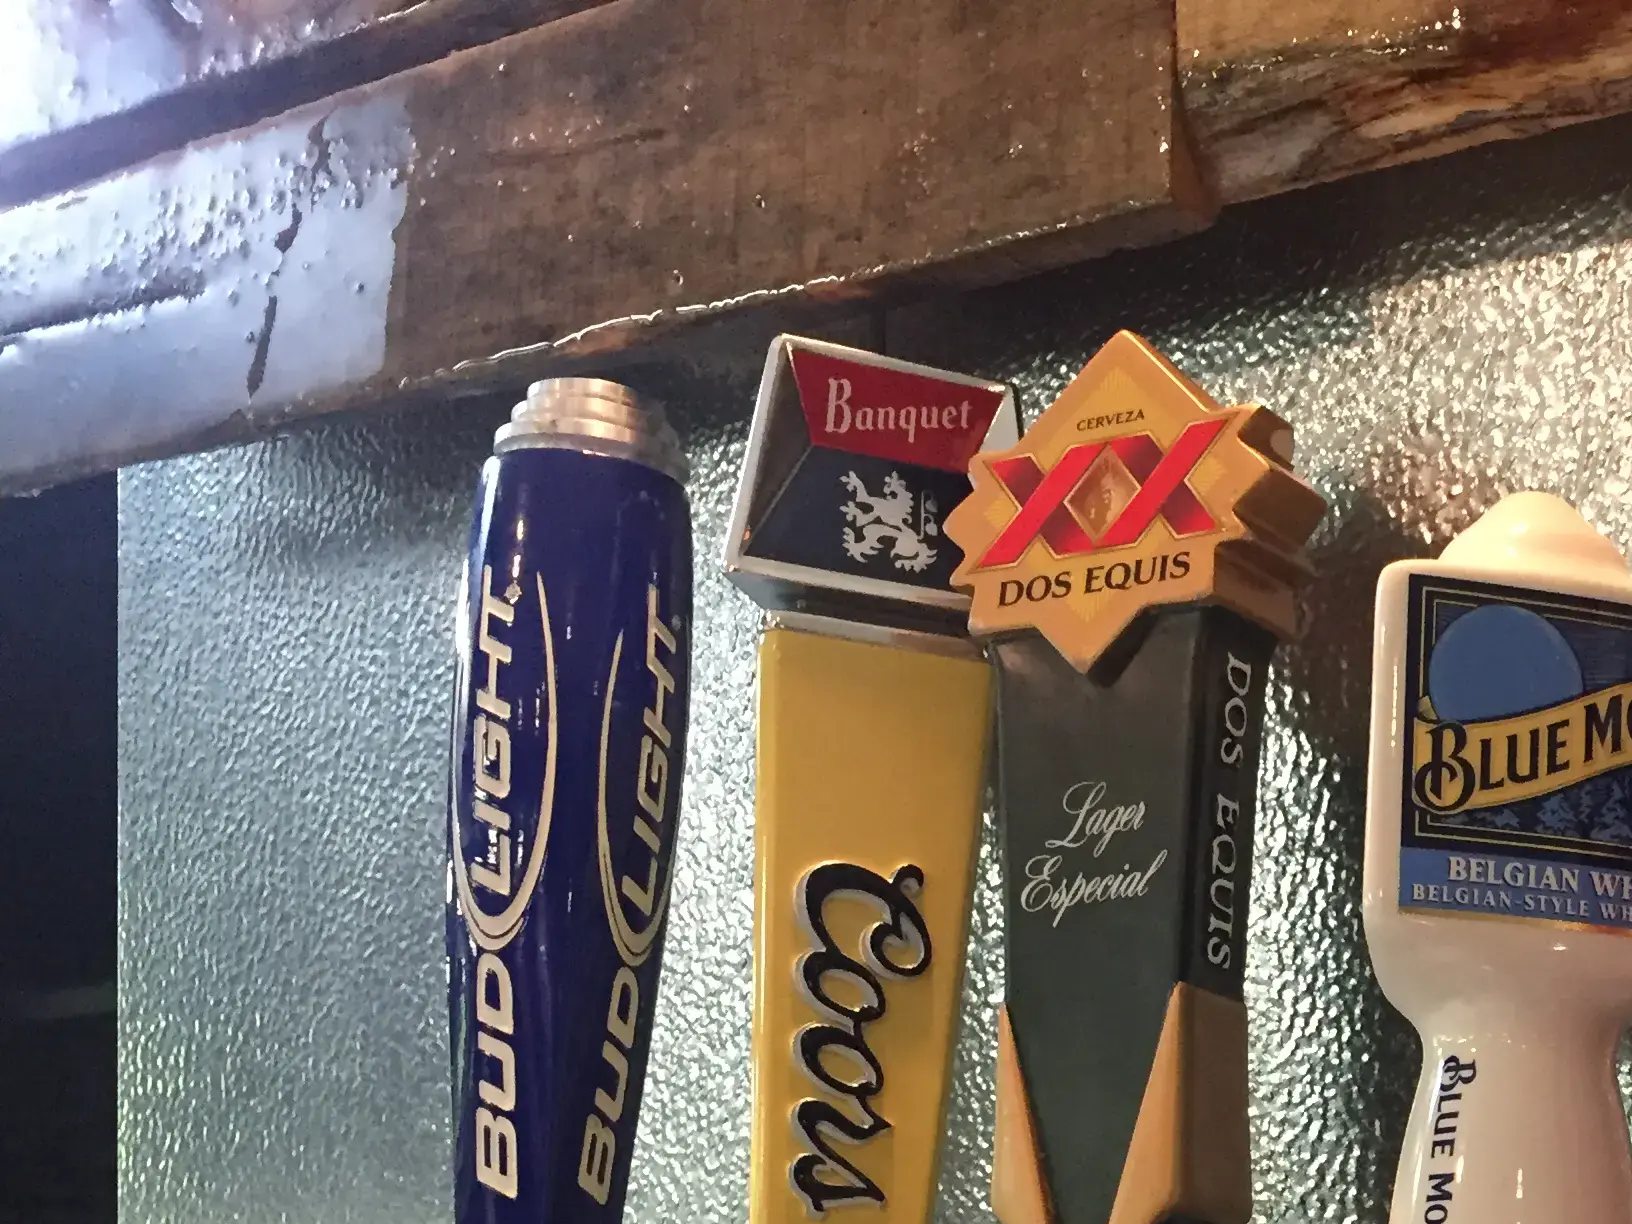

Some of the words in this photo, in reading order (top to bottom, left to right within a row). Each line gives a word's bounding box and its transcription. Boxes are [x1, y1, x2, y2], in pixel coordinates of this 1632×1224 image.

[824, 377, 975, 439] Banquet
[1076, 409, 1145, 432] CERVEZA
[997, 571, 1072, 608] DOS
[1084, 552, 1191, 595] EQUIS
[470, 563, 515, 897] LIGHT
[1220, 651, 1252, 769] DOS
[1414, 721, 1570, 812] BLUE
[1045, 781, 1147, 858] Lager
[576, 965, 641, 1207] BUD
[621, 583, 676, 918] LIGHT
[1020, 849, 1168, 928] Especial
[1207, 793, 1240, 970] EQUIS
[1412, 883, 1590, 917] BELGIAN-STYLE
[1448, 856, 1580, 894] BELGIAN
[475, 950, 518, 1201] BUD
[788, 862, 937, 1222] Coors
[1429, 1054, 1477, 1158] BLUE
